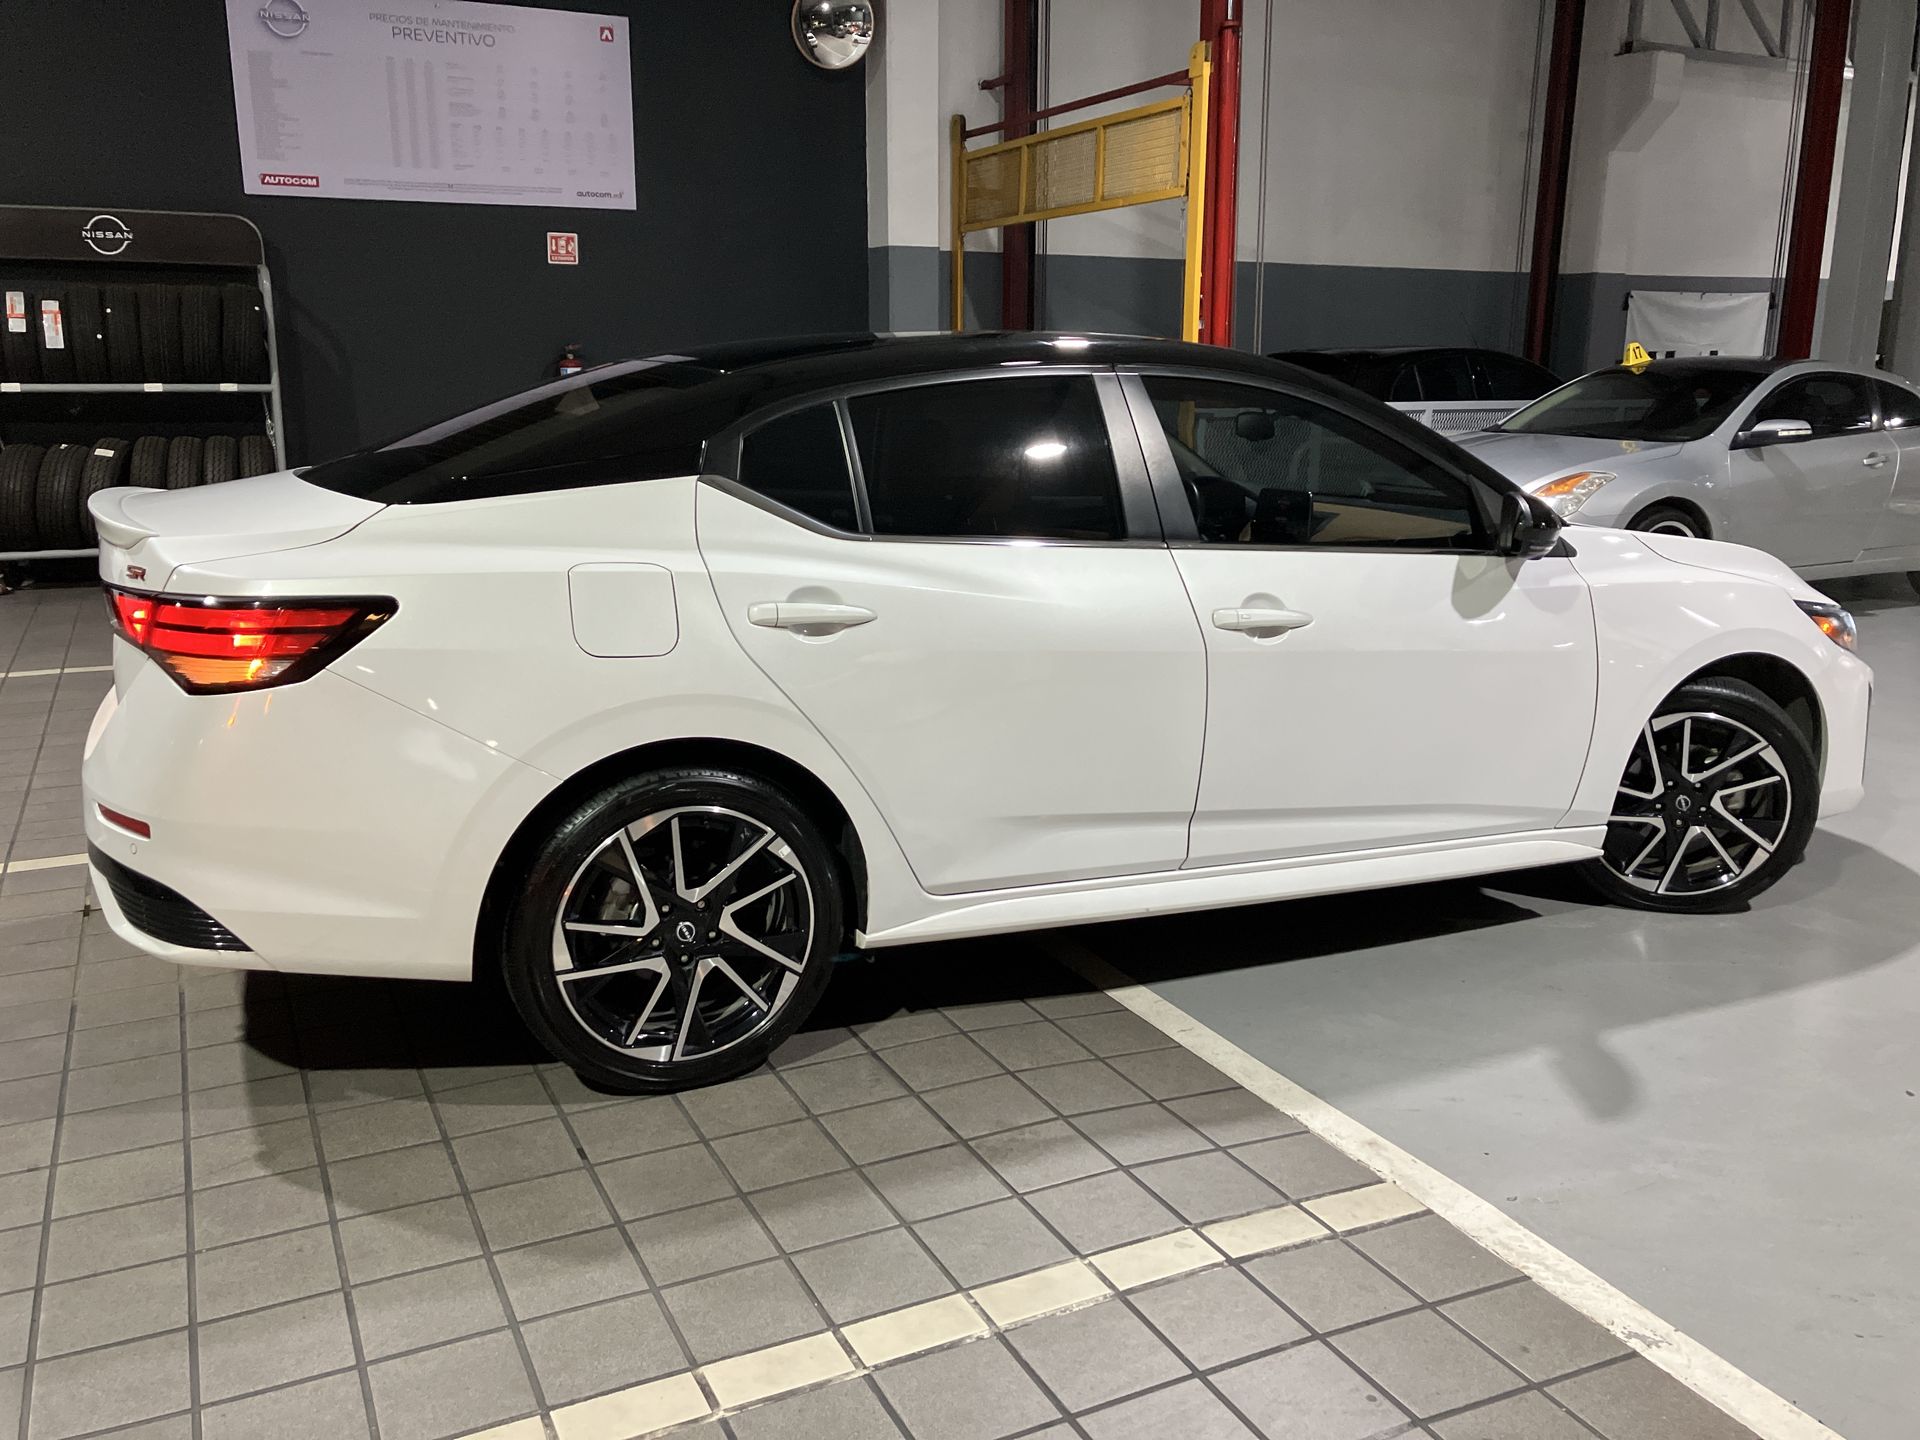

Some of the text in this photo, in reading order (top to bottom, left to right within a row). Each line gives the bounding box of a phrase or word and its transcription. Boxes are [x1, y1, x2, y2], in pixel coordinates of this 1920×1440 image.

[369, 12, 414, 25] PRECIOS
[415, 15, 430, 27] DE
[391, 26, 497, 48] PREVENTIVO
[264, 175, 317, 186] AUTOCOM
[82, 230, 133, 239] NISSAN
[1633, 346, 1642, 359] 17
[126, 564, 147, 581] SR
